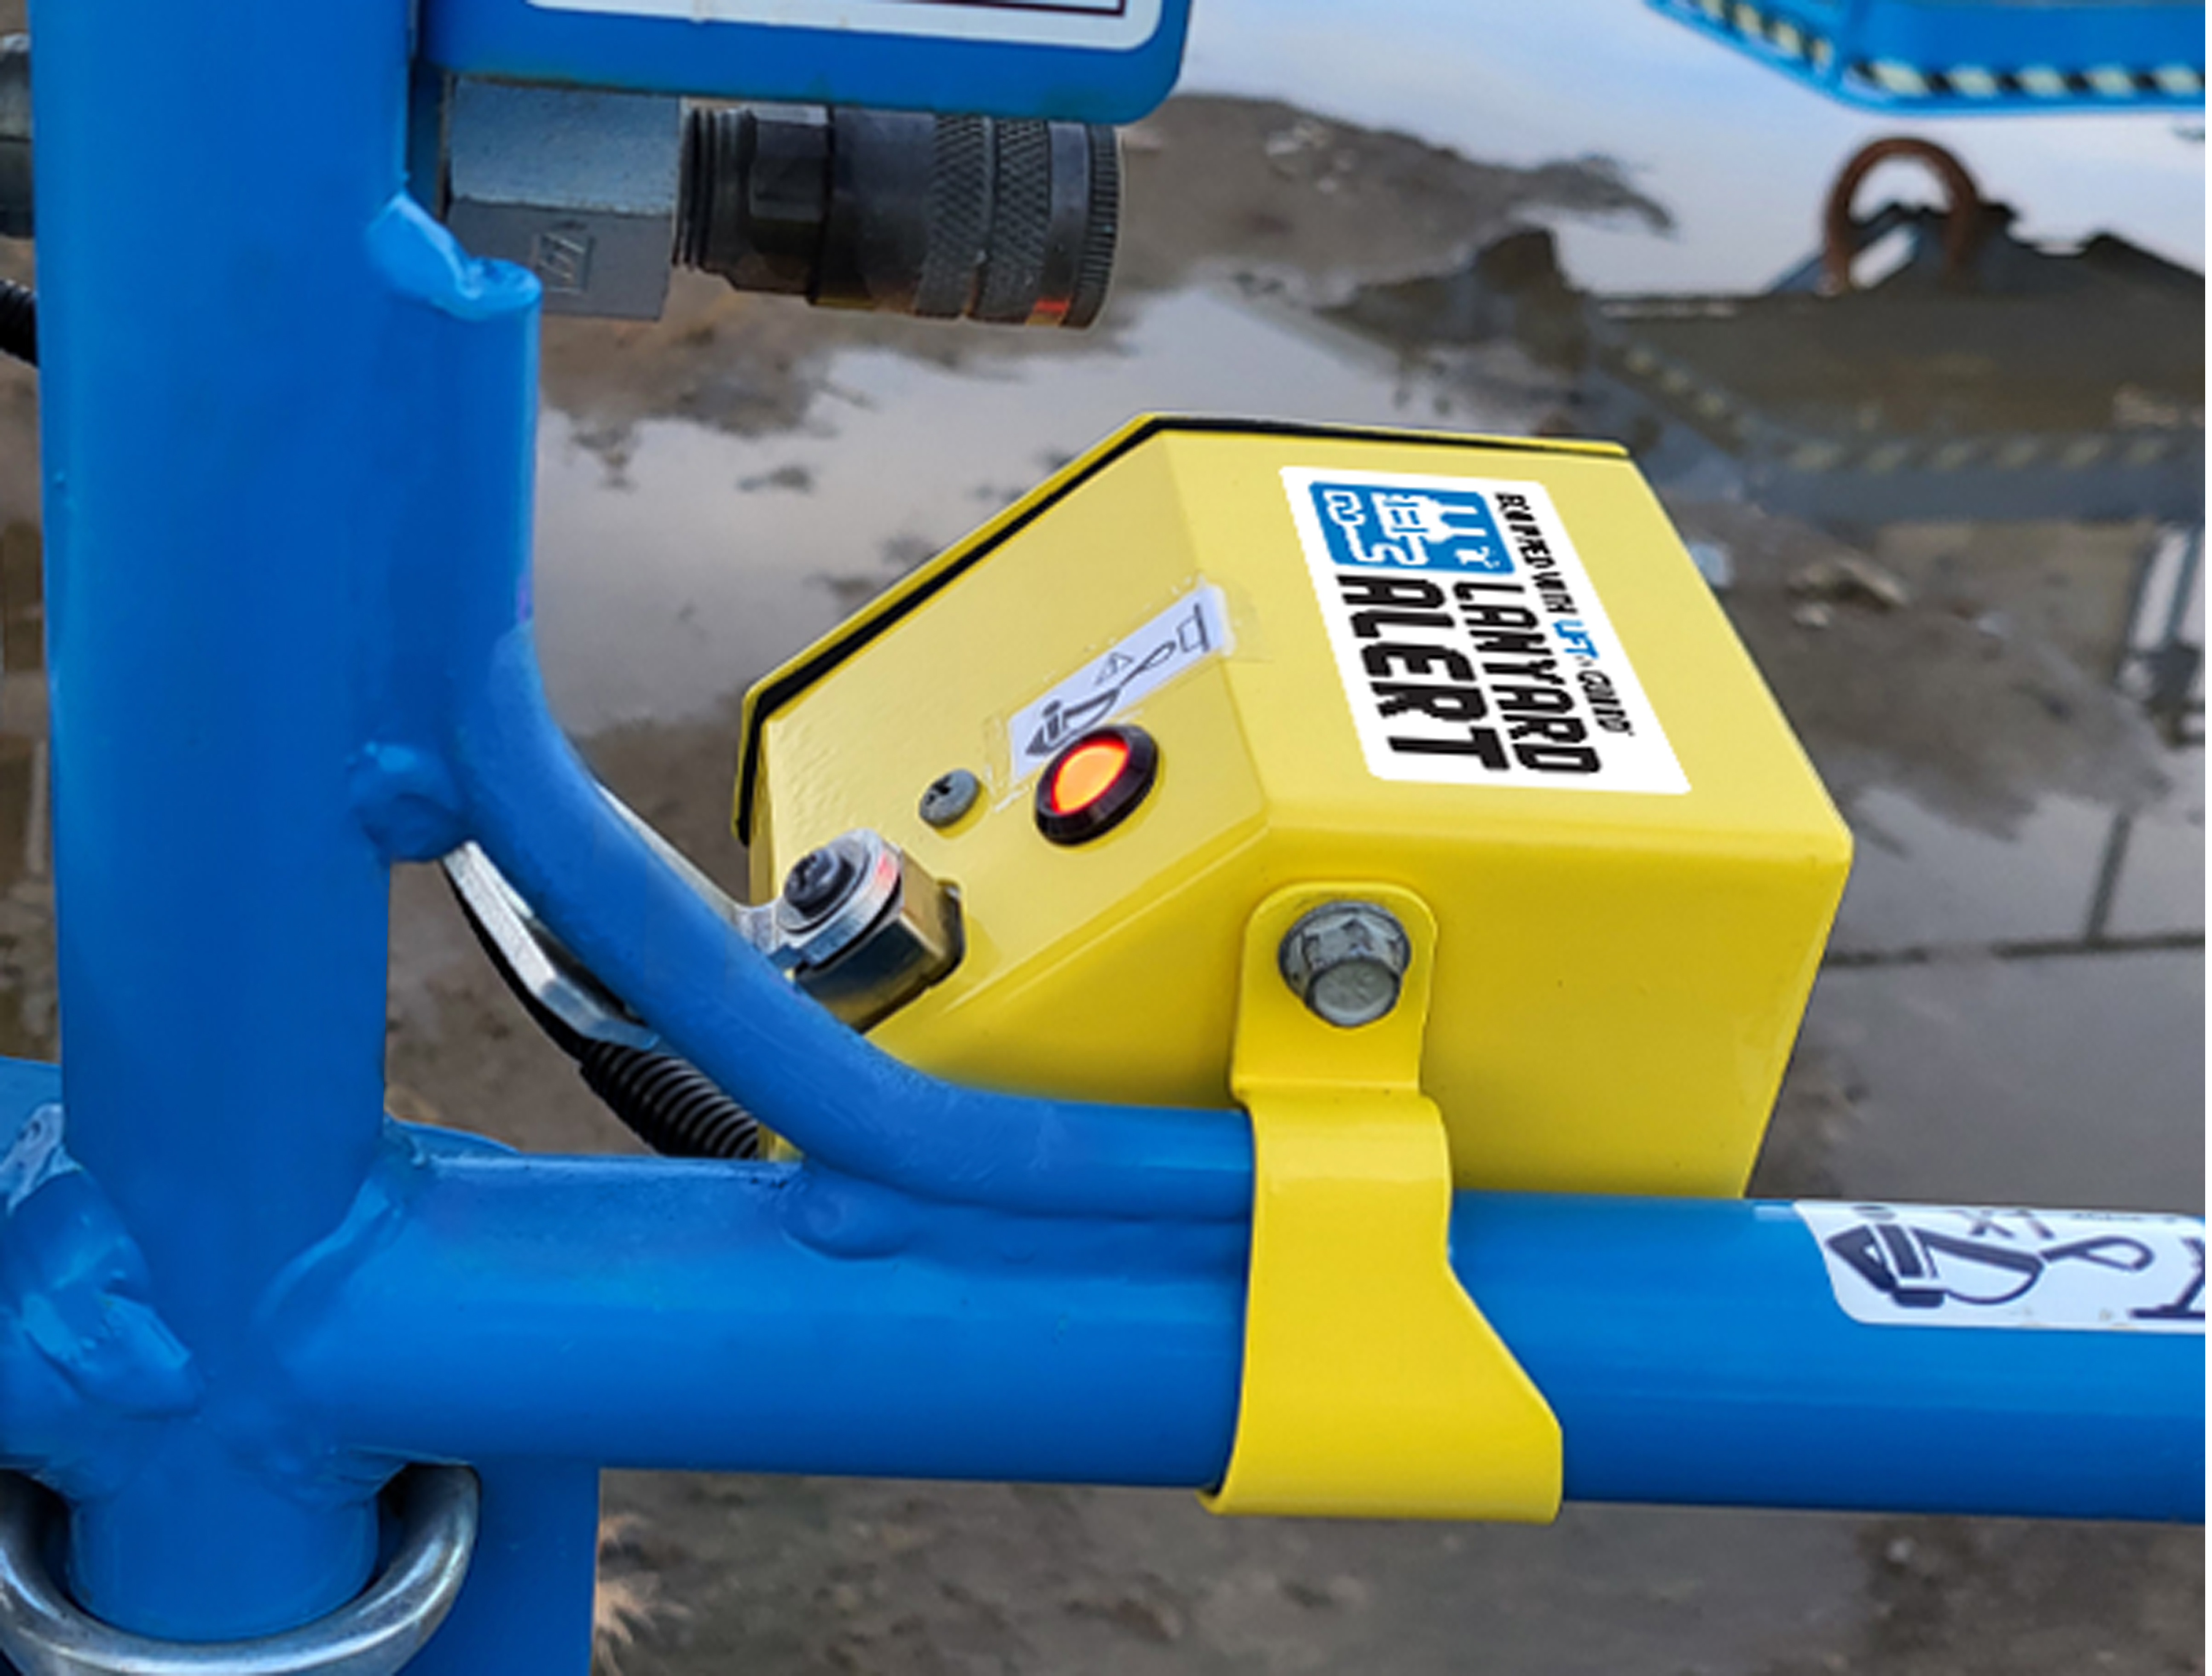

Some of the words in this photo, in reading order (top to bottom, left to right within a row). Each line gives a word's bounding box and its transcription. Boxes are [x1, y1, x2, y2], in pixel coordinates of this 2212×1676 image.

[1531, 572, 1577, 614] WITH
[1551, 619, 1600, 659] LIFT
[1336, 574, 1510, 771] ALERT
[1452, 581, 1601, 774] LANYARD
